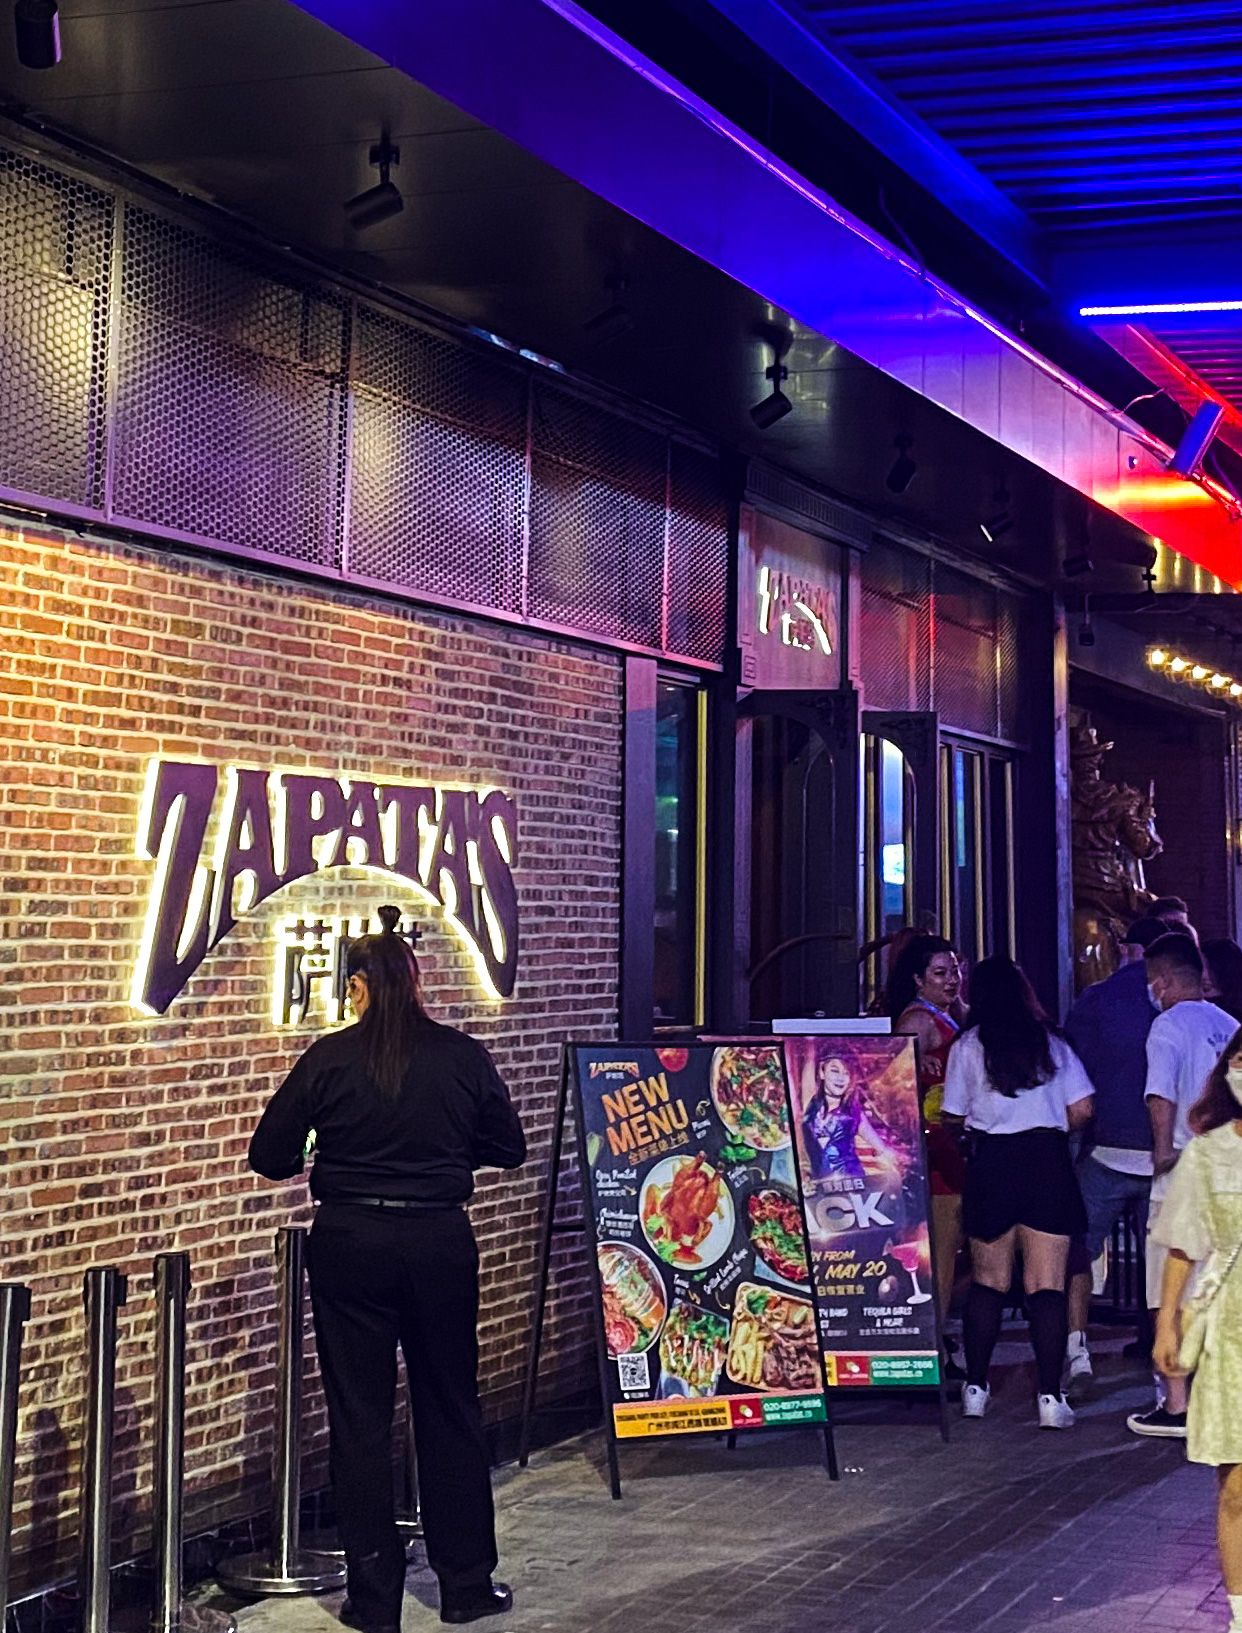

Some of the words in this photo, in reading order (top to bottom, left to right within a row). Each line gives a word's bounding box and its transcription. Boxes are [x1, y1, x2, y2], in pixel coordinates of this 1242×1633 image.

[601, 1072, 670, 1124] NEW
[606, 1098, 689, 1156] MENU
[823, 1250, 856, 1261] FROM
[824, 1263, 862, 1281] MAY
[862, 1260, 888, 1278] 20
